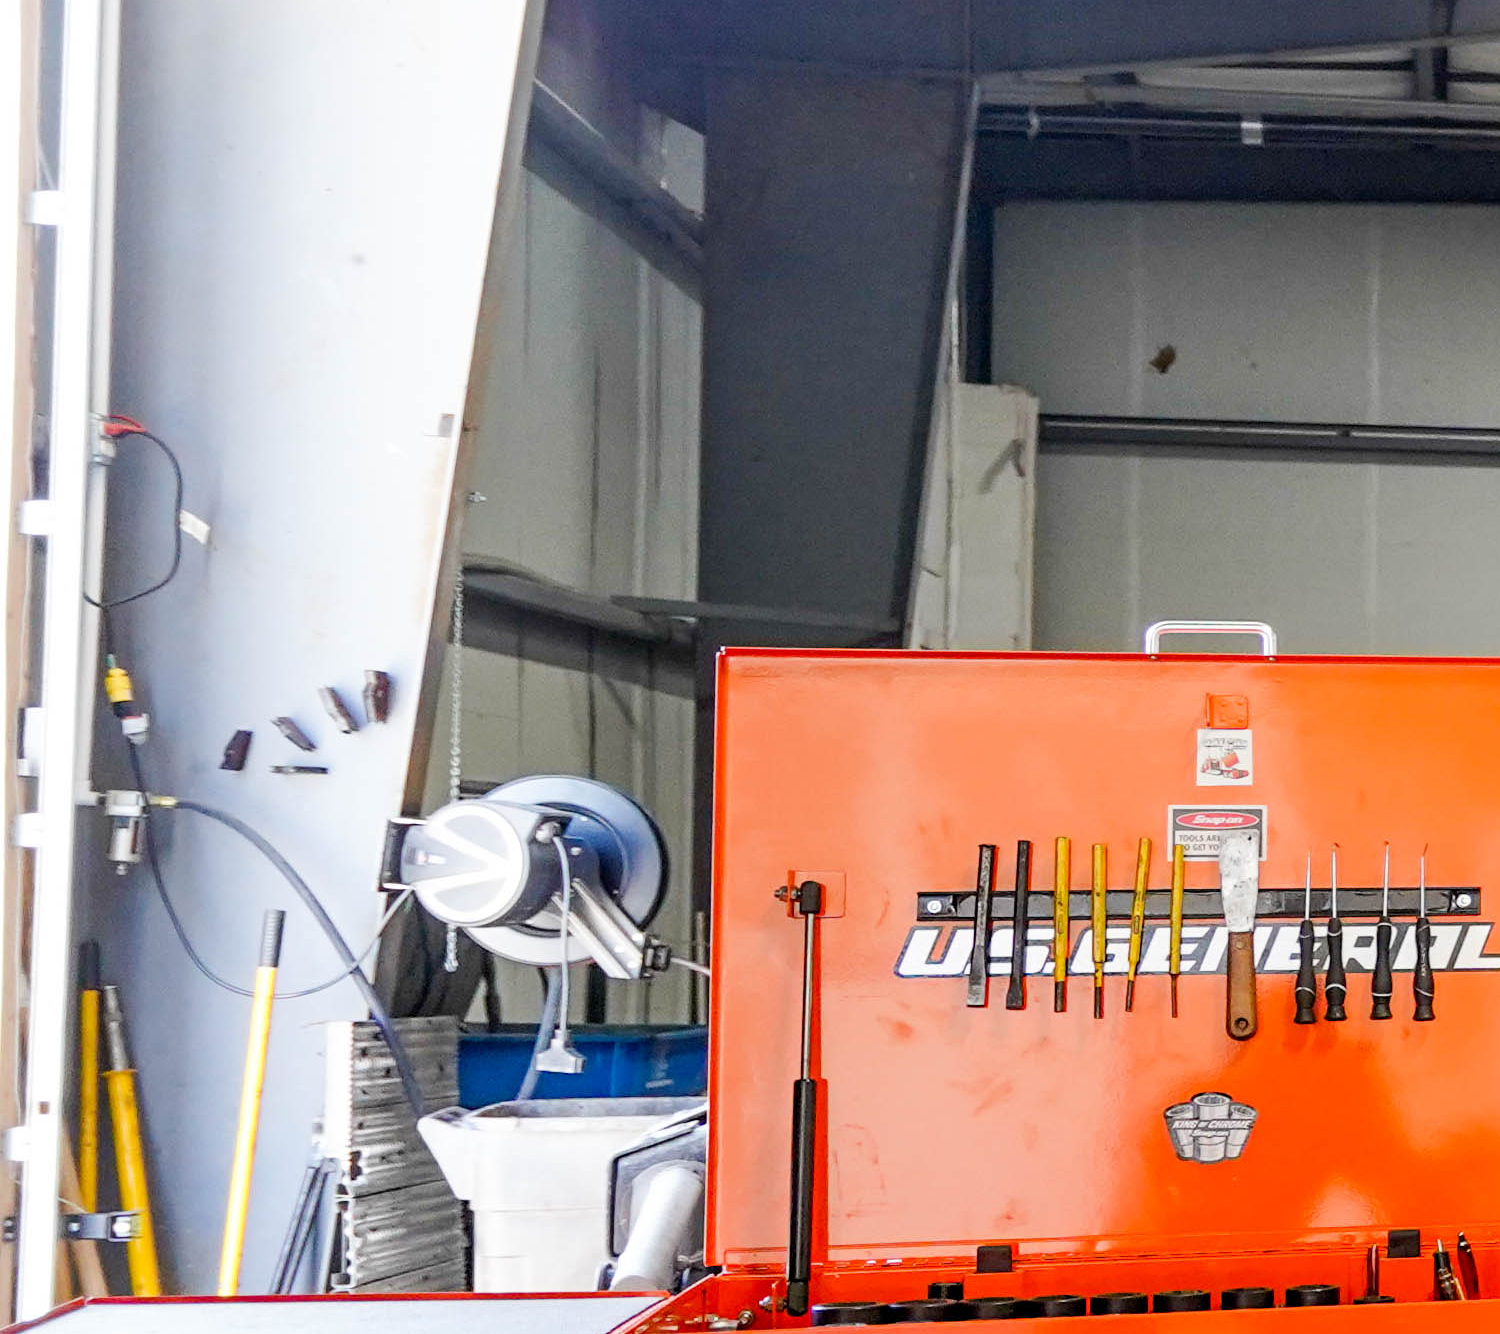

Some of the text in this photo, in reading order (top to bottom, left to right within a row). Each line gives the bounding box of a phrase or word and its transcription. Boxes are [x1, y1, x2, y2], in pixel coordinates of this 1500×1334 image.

[1178, 834, 1204, 842] TOOLS
[1173, 1120, 1198, 1129] KING
[1208, 1119, 1253, 1129] CHROME
